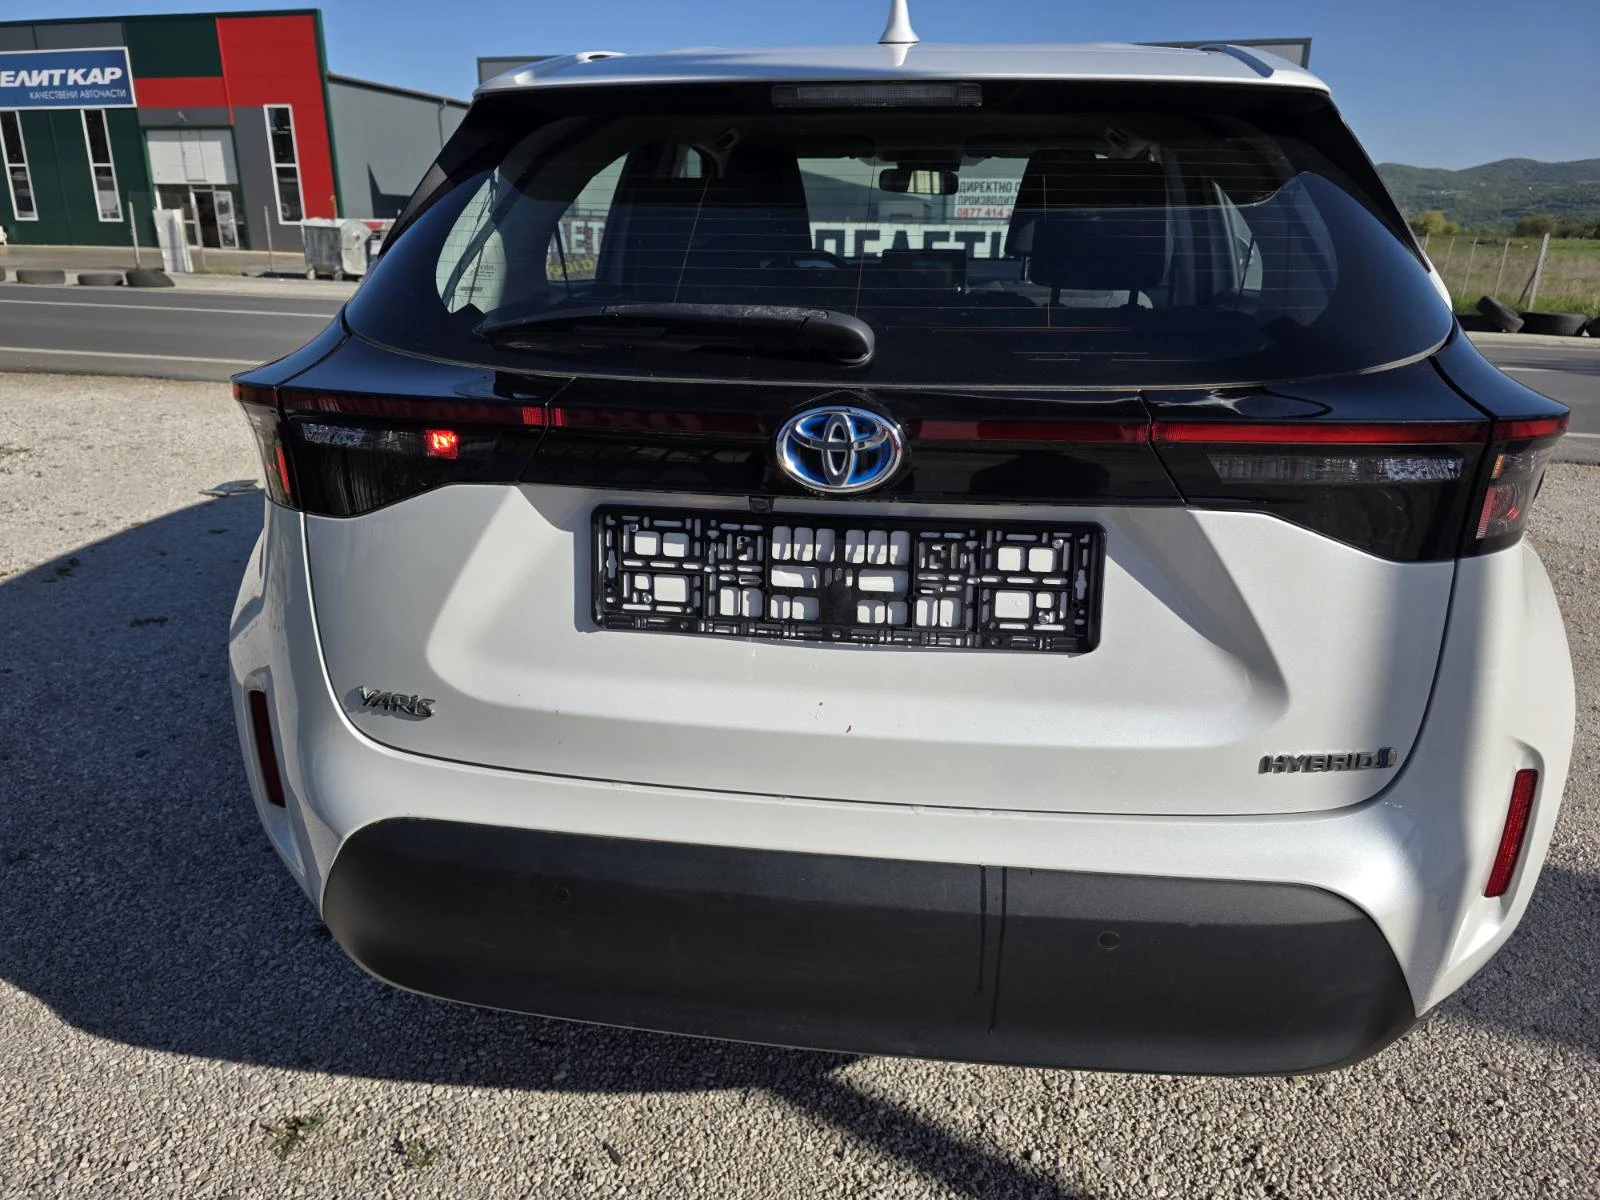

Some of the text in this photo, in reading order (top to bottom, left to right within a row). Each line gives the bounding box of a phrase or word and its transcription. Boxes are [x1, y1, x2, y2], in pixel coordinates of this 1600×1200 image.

[29, 89, 126, 99] КАЧЕСТВЕНИ АВТОЧАСТИ
[957, 195, 1017, 206] ПРОИЗВОДИТ
[1258, 752, 1375, 774] HYBRID
